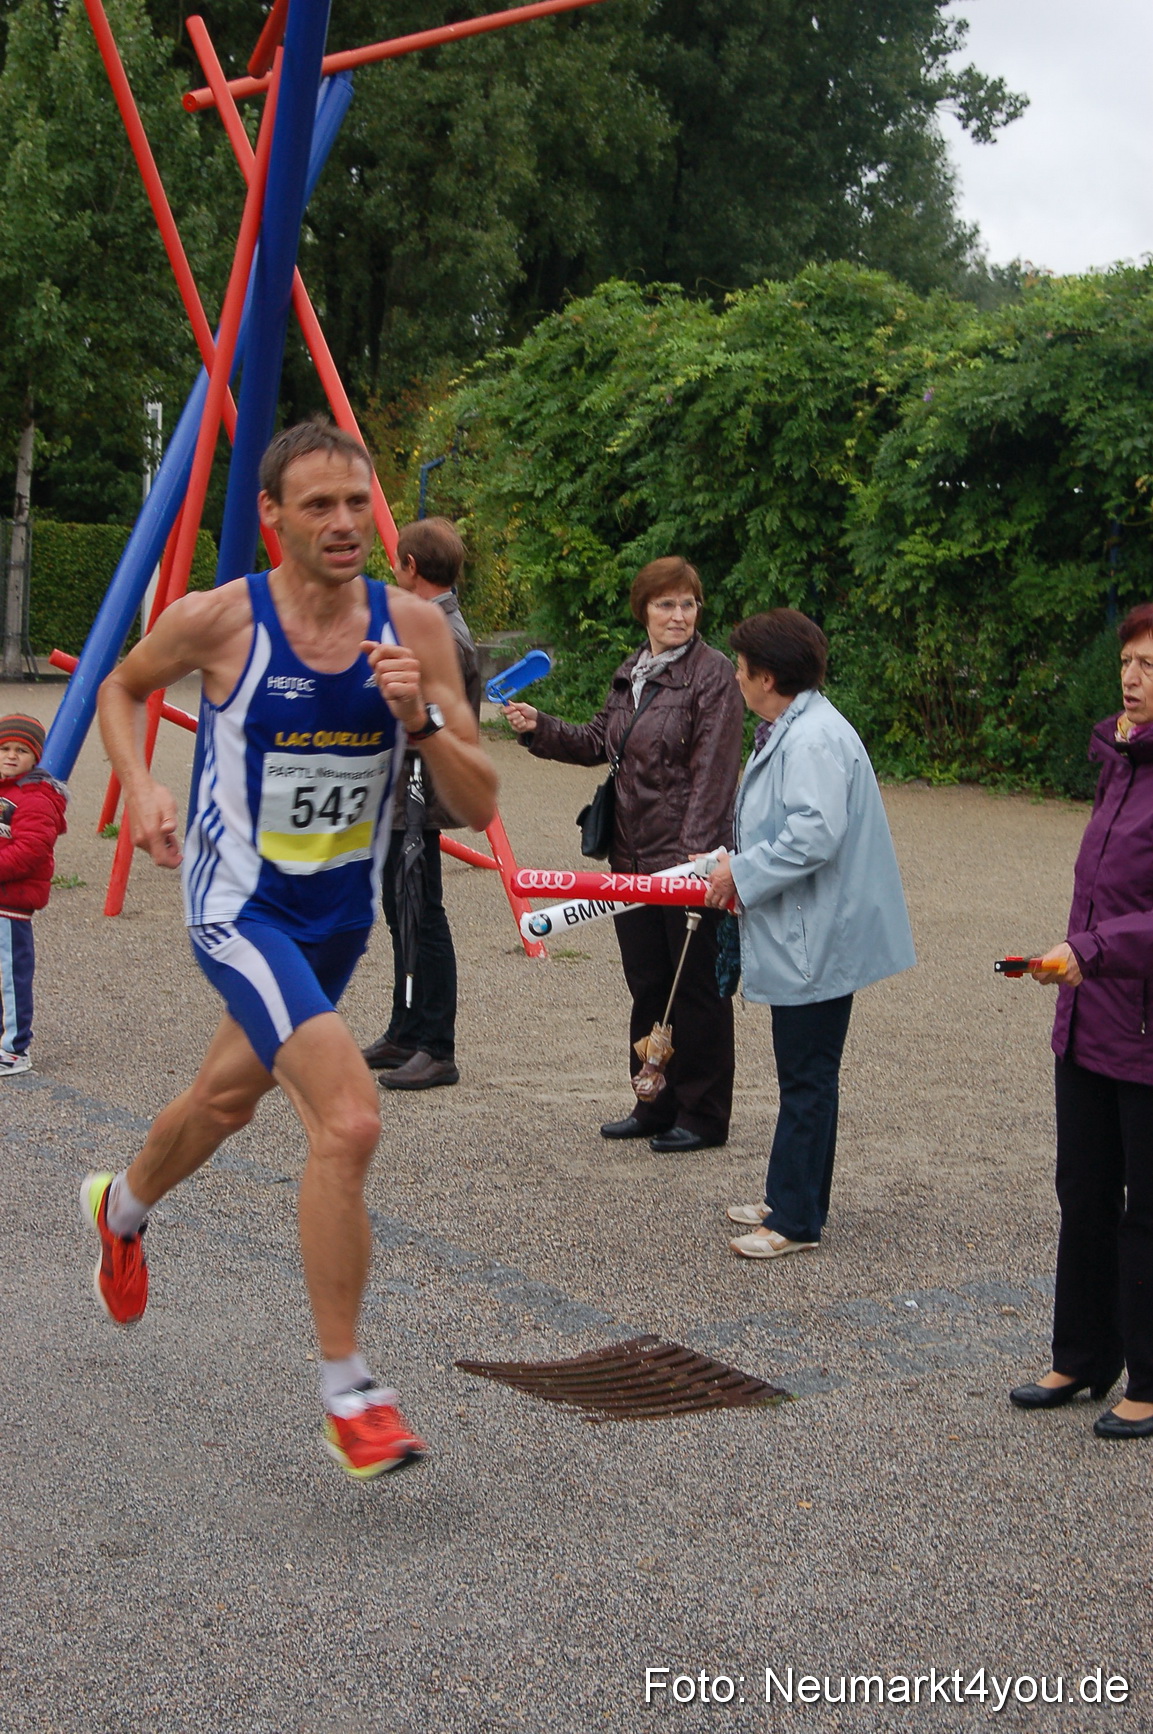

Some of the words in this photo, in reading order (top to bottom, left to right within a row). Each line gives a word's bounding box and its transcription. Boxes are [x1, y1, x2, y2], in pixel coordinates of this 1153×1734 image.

[266, 675, 317, 692] HEITEC
[275, 731, 312, 747] LAC
[312, 729, 384, 749] QUELLE
[290, 785, 369, 829] 543
[598, 873, 652, 893] BKK
[563, 899, 616, 926] BMW
